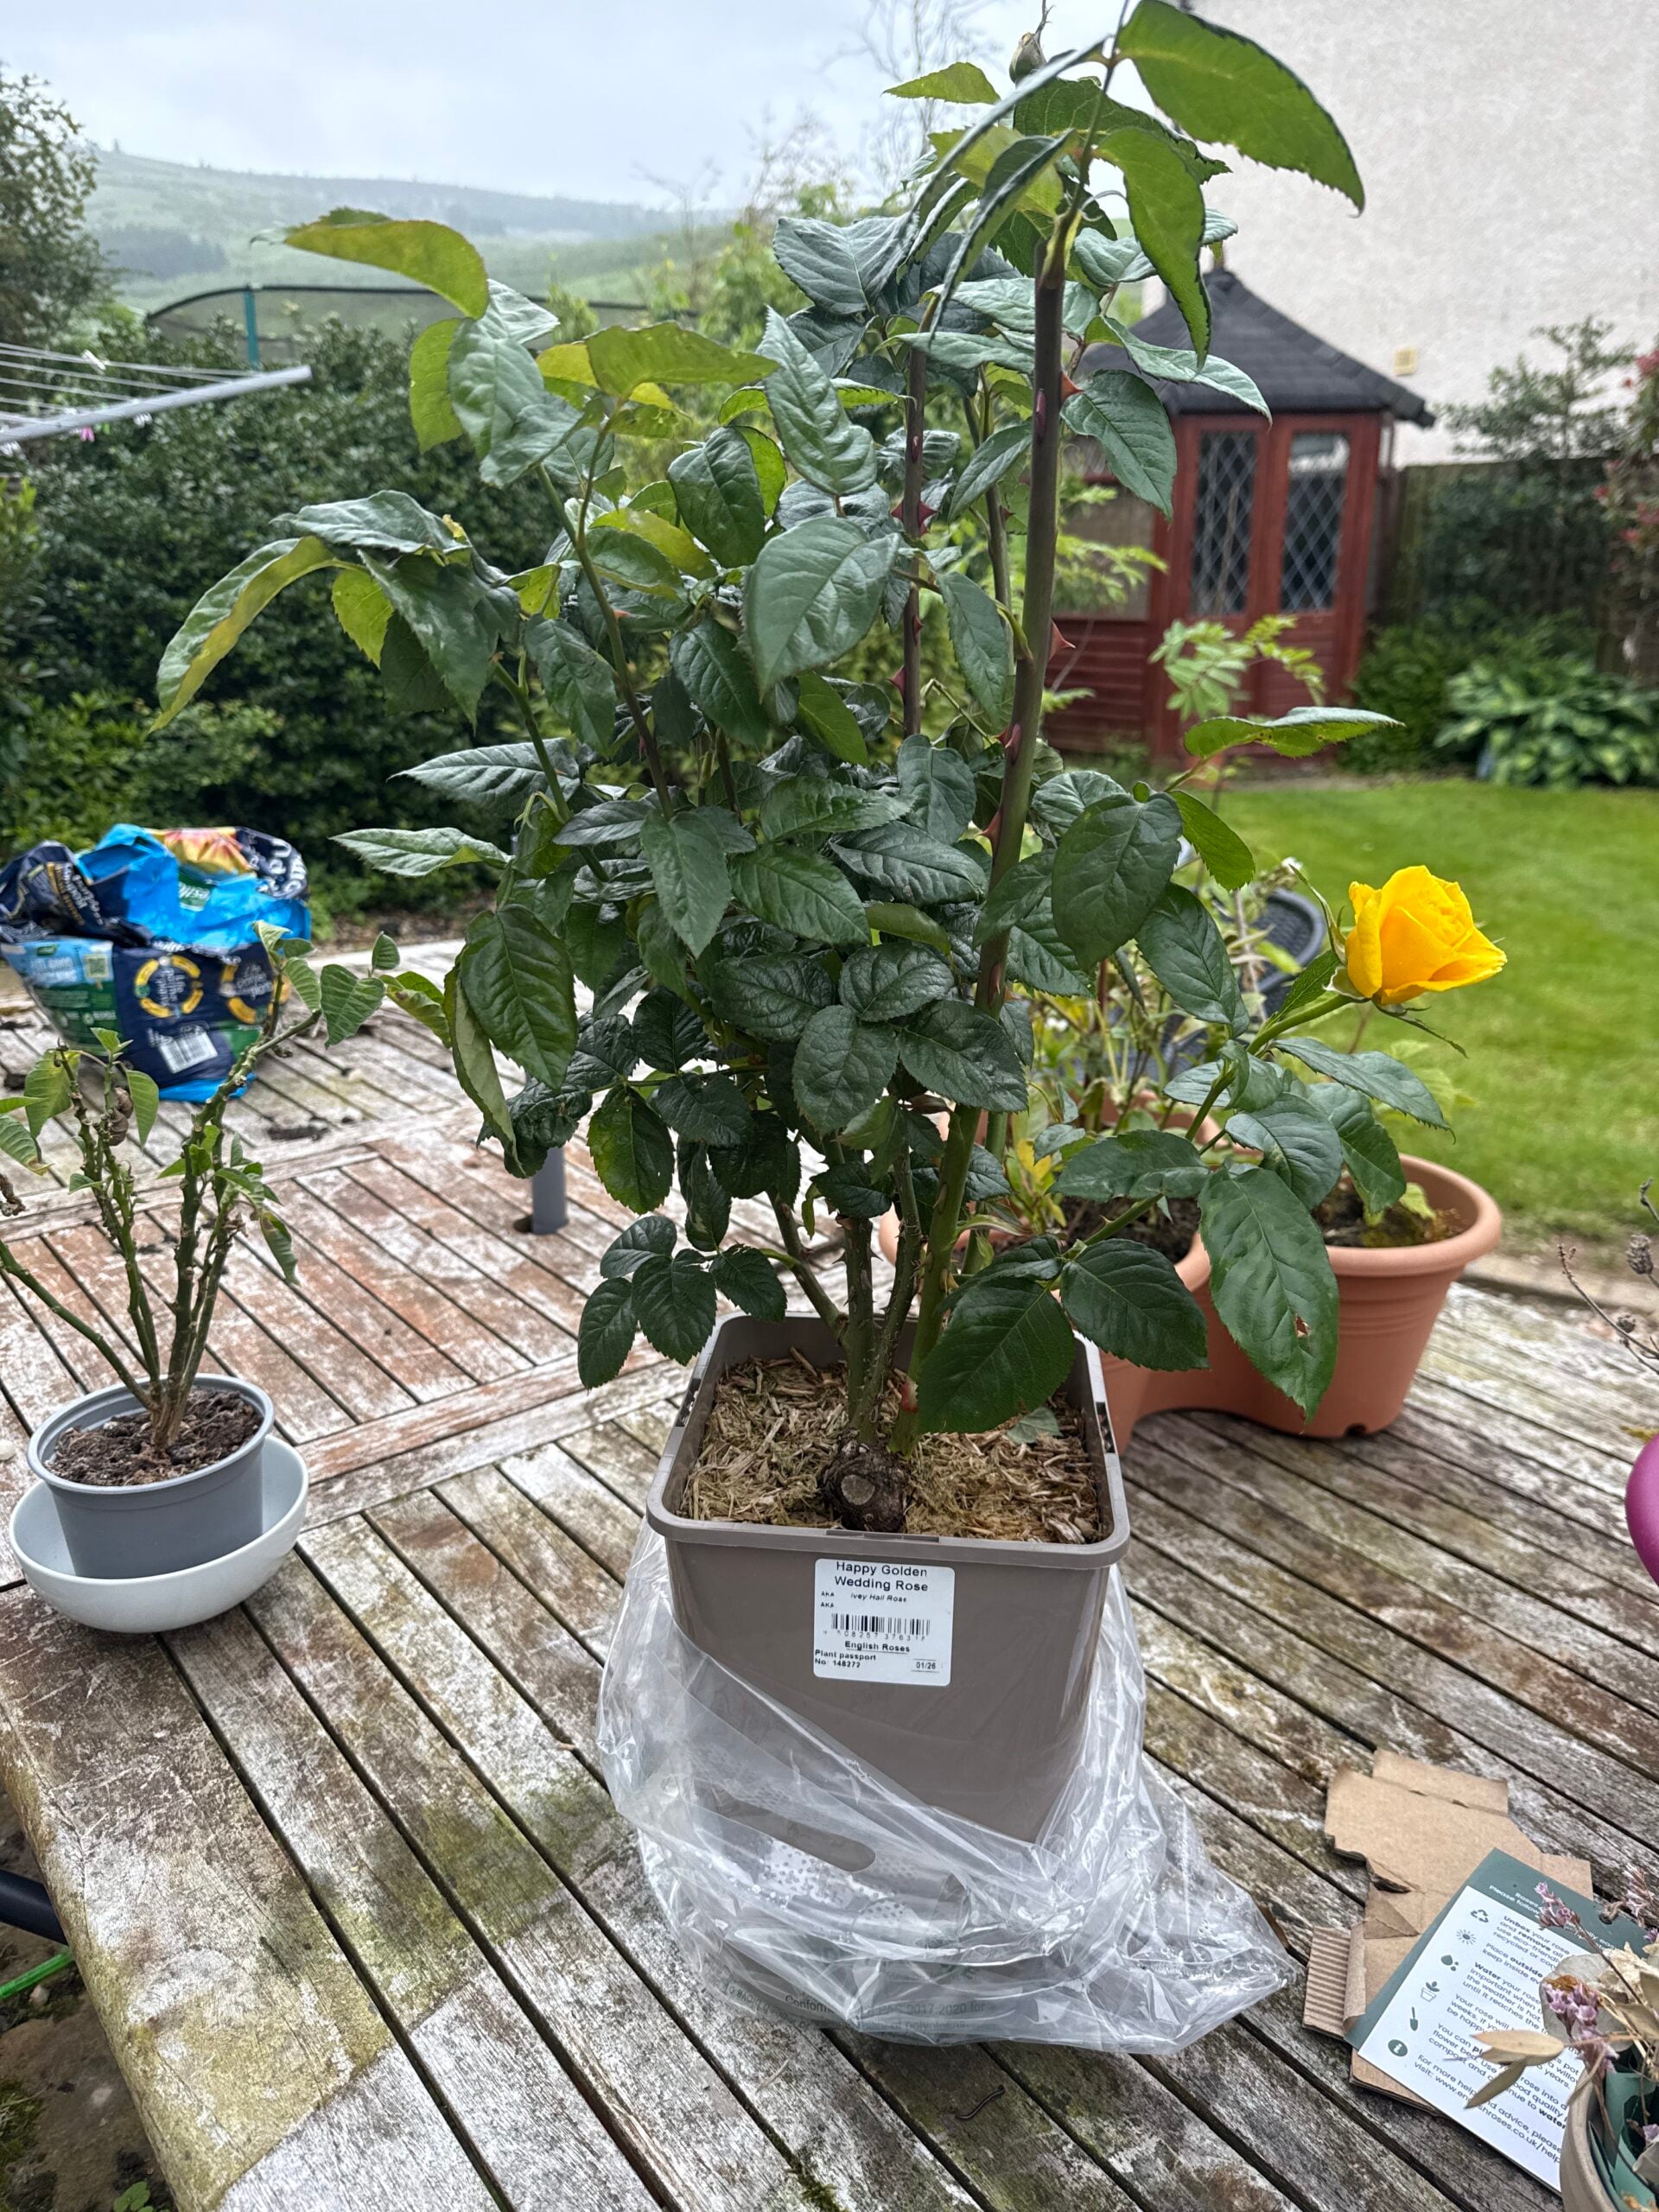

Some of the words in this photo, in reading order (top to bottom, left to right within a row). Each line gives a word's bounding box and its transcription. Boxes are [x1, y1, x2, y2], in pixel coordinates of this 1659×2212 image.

[835, 1576, 891, 1592] Wedding
[895, 1580, 929, 1592] Rose
[836, 1560, 877, 1576] Happy
[881, 1565, 927, 1576] Golden
[816, 1649, 836, 1657] Plant
[840, 1652, 876, 1661] passport
[845, 1640, 879, 1650] English
[881, 1643, 910, 1652] Roses
[1489, 1885, 1516, 1901] Please
[1516, 1899, 1540, 1915] follow
[1515, 1892, 1538, 1908] Roses
[1493, 1932, 1529, 1954] recycled
[1497, 1926, 1512, 1937] use
[1513, 1936, 1560, 1963] eco-friendl
[1500, 1922, 1517, 1932] and
[1517, 1930, 1551, 1951] remove
[1503, 1916, 1531, 1934] Unbox
[1532, 1932, 1550, 1944] your
[1552, 1942, 1570, 1955] rose
[1482, 1948, 1503, 1963] keep
[1503, 1960, 1529, 1979] inside
[1486, 1942, 1509, 1958] Place
[1510, 1956, 1543, 1978] outside
[1466, 1974, 1480, 1986] the
[1481, 1983, 1516, 2006] weather
[1526, 2010, 1541, 2022] hot.
[1470, 1968, 1512, 1996] important
[1513, 1994, 1536, 2010] when
[1474, 1961, 1501, 1980] Water
[1502, 1979, 1522, 1993] your
[1522, 1991, 1541, 2005] rose
[970, 2003, 986, 2012] for
[1451, 2001, 1478, 2020] weeks.
[1462, 1980, 1480, 1994] until
[1490, 1997, 1524, 2020] reaches
[1525, 2018, 1540, 2030] the
[1446, 2006, 1459, 2017] be
[1544, 2069, 1571, 2089] years.
[1455, 1993, 1474, 2008] Your
[1474, 2006, 1493, 2020] rose
[1495, 2018, 1510, 2029] will
[1562, 2063, 1580, 2076] pot
[1414, 2062, 1433, 2077] visit:
[1433, 2031, 1459, 2050] flower
[1460, 2048, 1478, 2063] bed.
[1481, 2060, 1497, 2074] Use
[1514, 2082, 1531, 2096] ood
[1533, 2094, 1564, 2118] quality
[1438, 2023, 1453, 2037] You
[1454, 2035, 1471, 2048] can
[1521, 2077, 1540, 2092] rose
[1541, 2089, 1559, 2105] into
[1429, 2037, 1466, 2064] compost
[1468, 2063, 1486, 2077] and
[1528, 2100, 1537, 2110] to
[1539, 2108, 1566, 2129] water
[1417, 2055, 1432, 2066] For
[1433, 2064, 1457, 2082] more
[1458, 2079, 1478, 2096] help
[1498, 2108, 1529, 2133] advice,
[1531, 2130, 1562, 2153] please
